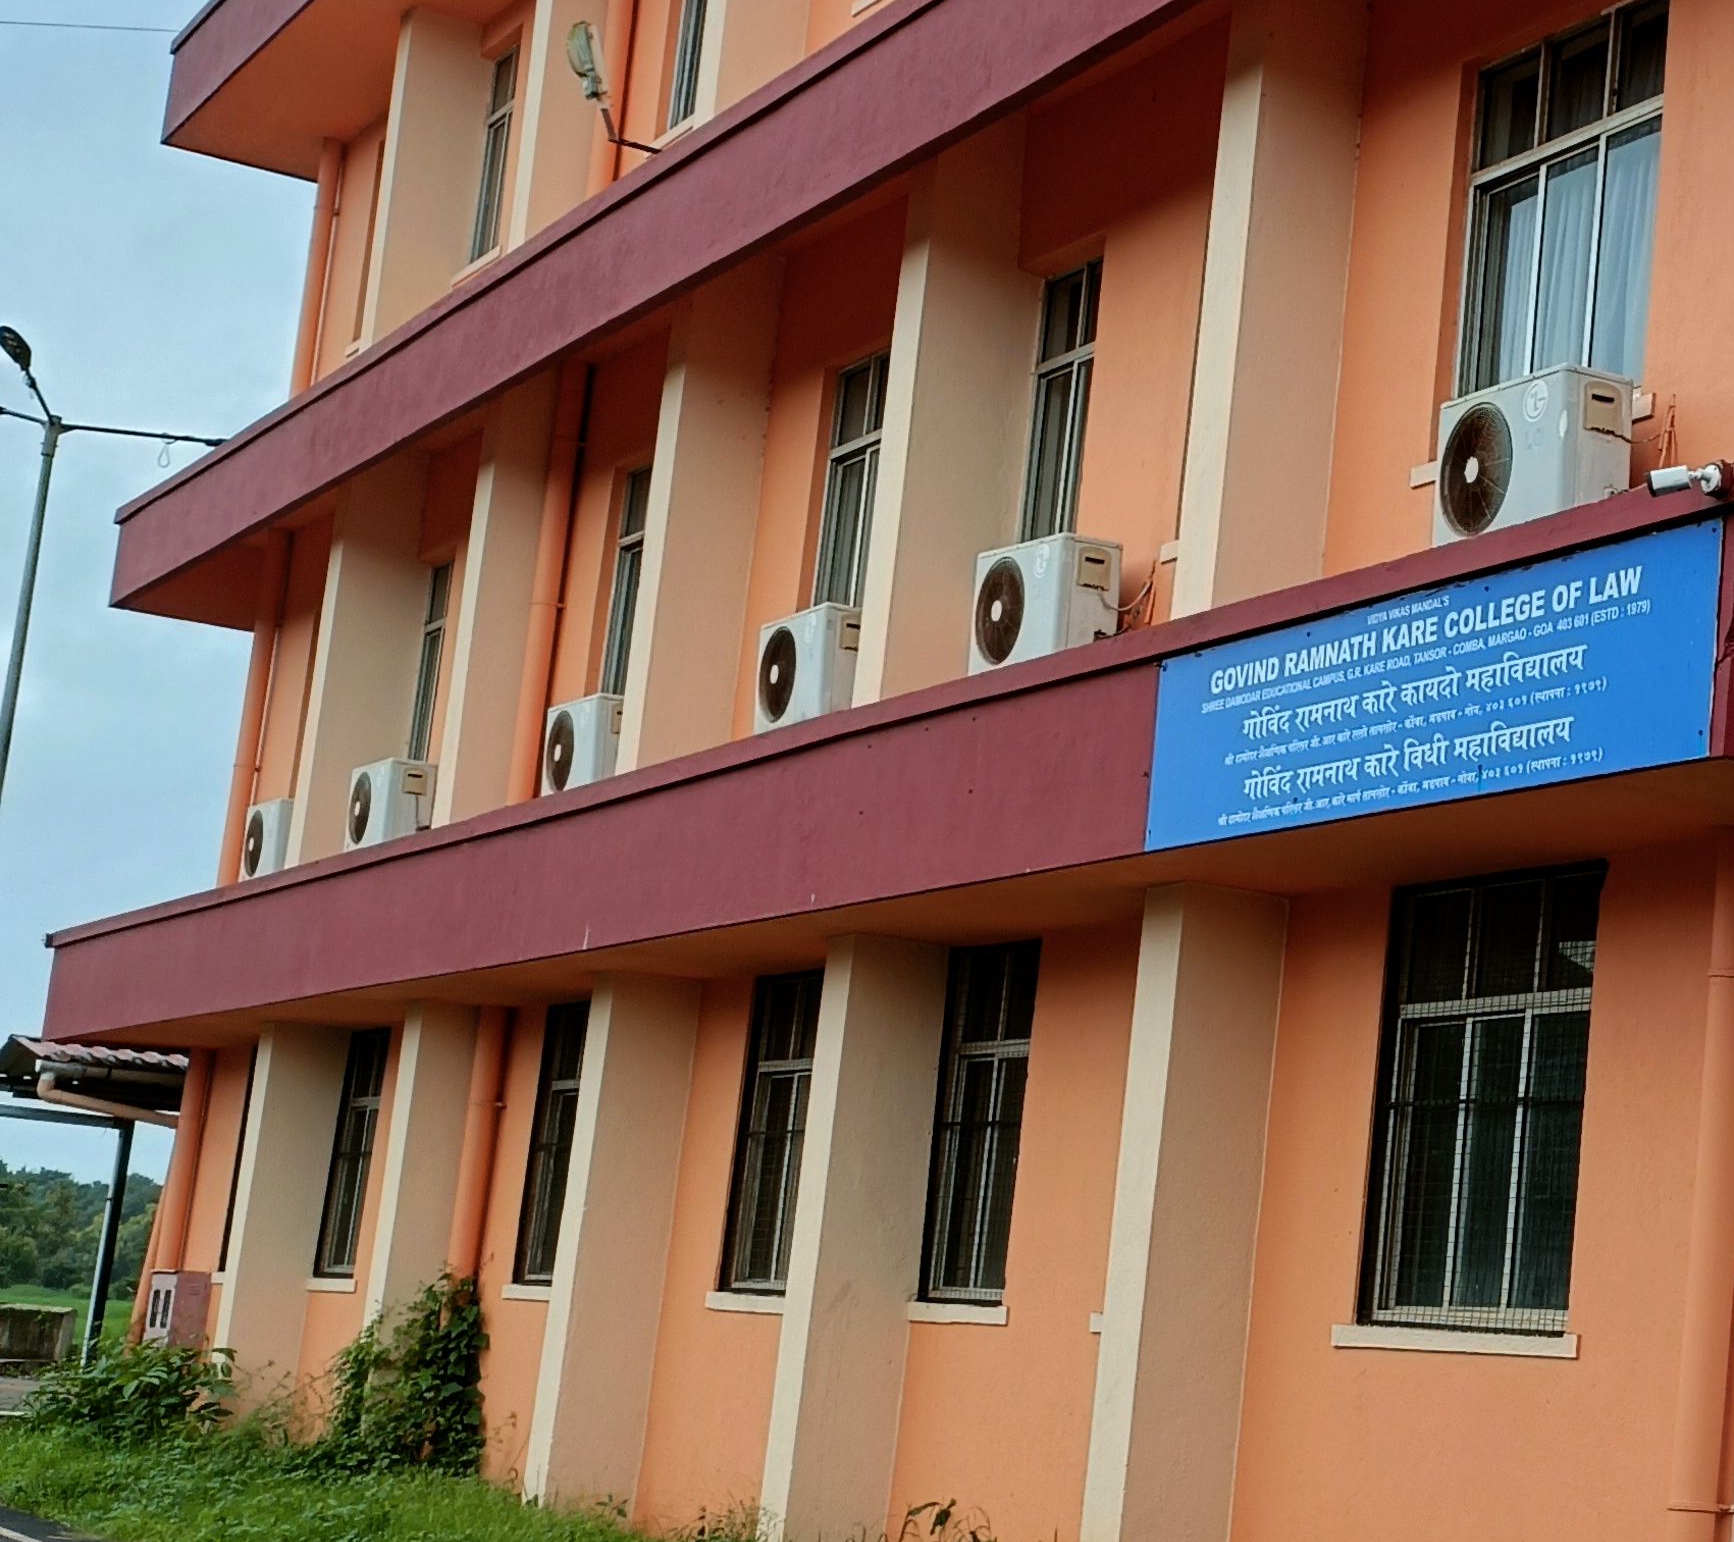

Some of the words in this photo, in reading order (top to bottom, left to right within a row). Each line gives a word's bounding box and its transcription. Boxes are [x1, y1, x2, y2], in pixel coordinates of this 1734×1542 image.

[1210, 656, 1280, 695] GOVIND
[1283, 630, 1377, 677] RAMNATH
[1381, 616, 1439, 654] KARE
[1444, 589, 1546, 638] COLLEGE
[1551, 580, 1583, 613] OF
[1588, 565, 1643, 605] LAW
[1487, 627, 1527, 648] MARGAO
[1533, 621, 1554, 637] GOA
[1556, 616, 1573, 631] 403
[1242, 704, 1293, 740] गोविंद
[1294, 694, 1360, 733] रामनाथ
[1361, 680, 1398, 715] कारे
[1400, 665, 1463, 707] कायदो
[1465, 644, 1588, 693] महाविद्यालय
[1243, 764, 1295, 800] गोविंद
[1296, 757, 1362, 794] रामनाथ
[1363, 743, 1401, 778] कारे
[1403, 732, 1450, 772] विधी
[1453, 716, 1575, 762] महाविद्यालय
